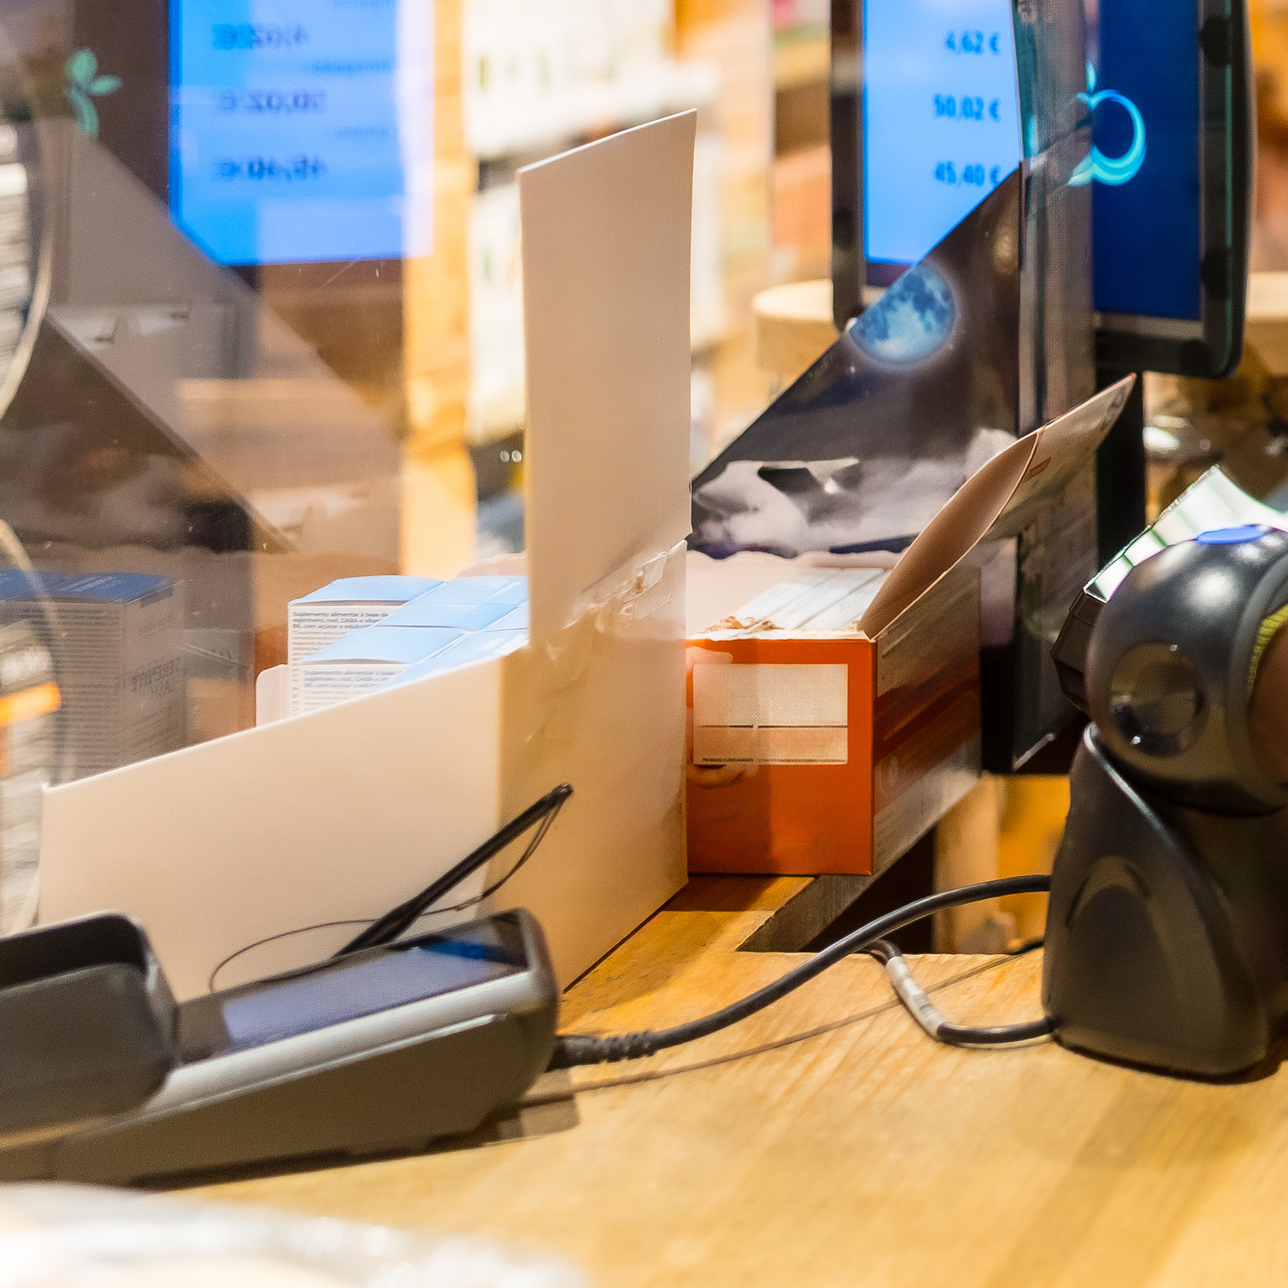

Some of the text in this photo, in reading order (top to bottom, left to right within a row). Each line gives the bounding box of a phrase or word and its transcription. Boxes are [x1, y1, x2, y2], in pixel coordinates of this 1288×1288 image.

[945, 30, 1001, 55] 4,62 €
[934, 93, 1001, 122] 50,02 €
[935, 161, 985, 187] 45,40
